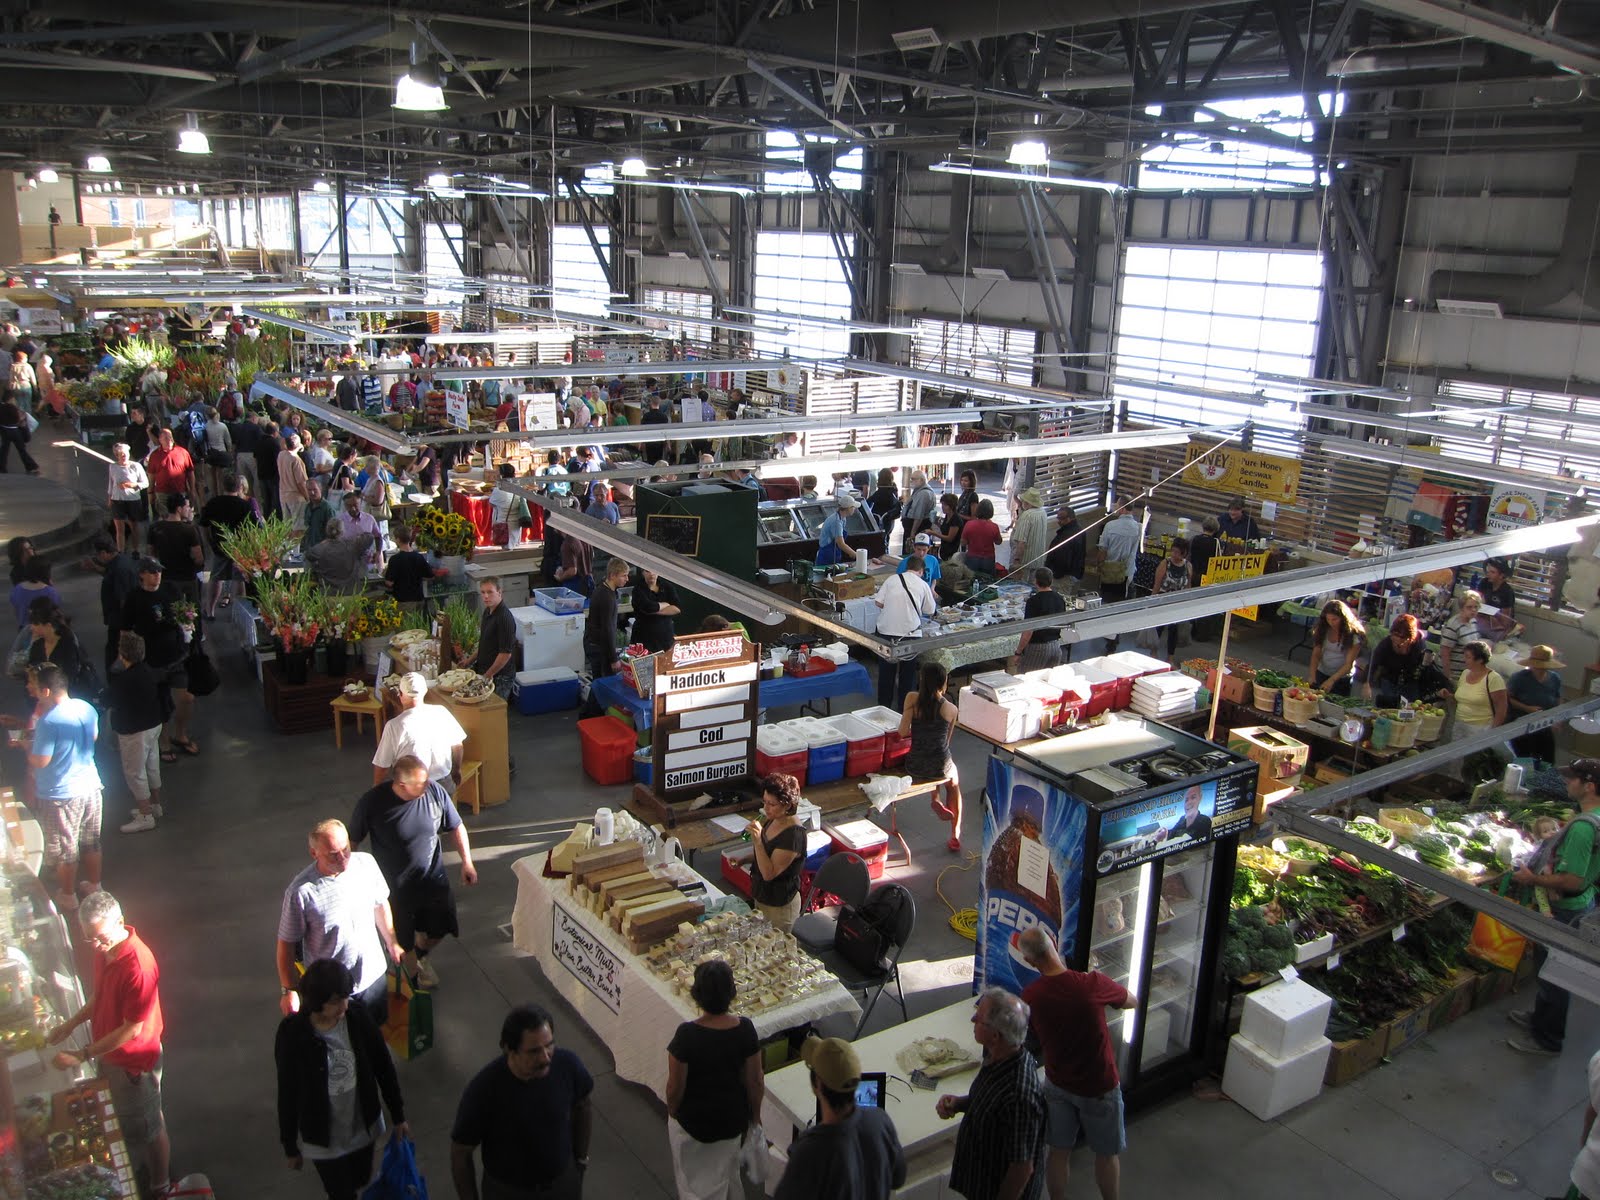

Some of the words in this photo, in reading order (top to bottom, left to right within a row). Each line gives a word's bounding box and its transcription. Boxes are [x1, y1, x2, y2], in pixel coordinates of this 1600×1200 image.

[1189, 447, 1230, 468] HONEY
[1260, 460, 1283, 472] Honey
[1239, 467, 1272, 480] Beeswax
[1238, 477, 1269, 489] Candles
[1488, 519, 1511, 530] River
[1214, 557, 1261, 572] HUTTEN
[697, 637, 742, 650] FRESH
[673, 646, 741, 659] SEAFOODS
[670, 670, 726, 690] Haddock
[699, 727, 724, 743] Cod
[666, 768, 705, 787] Salmon
[706, 762, 746, 782] Burgers
